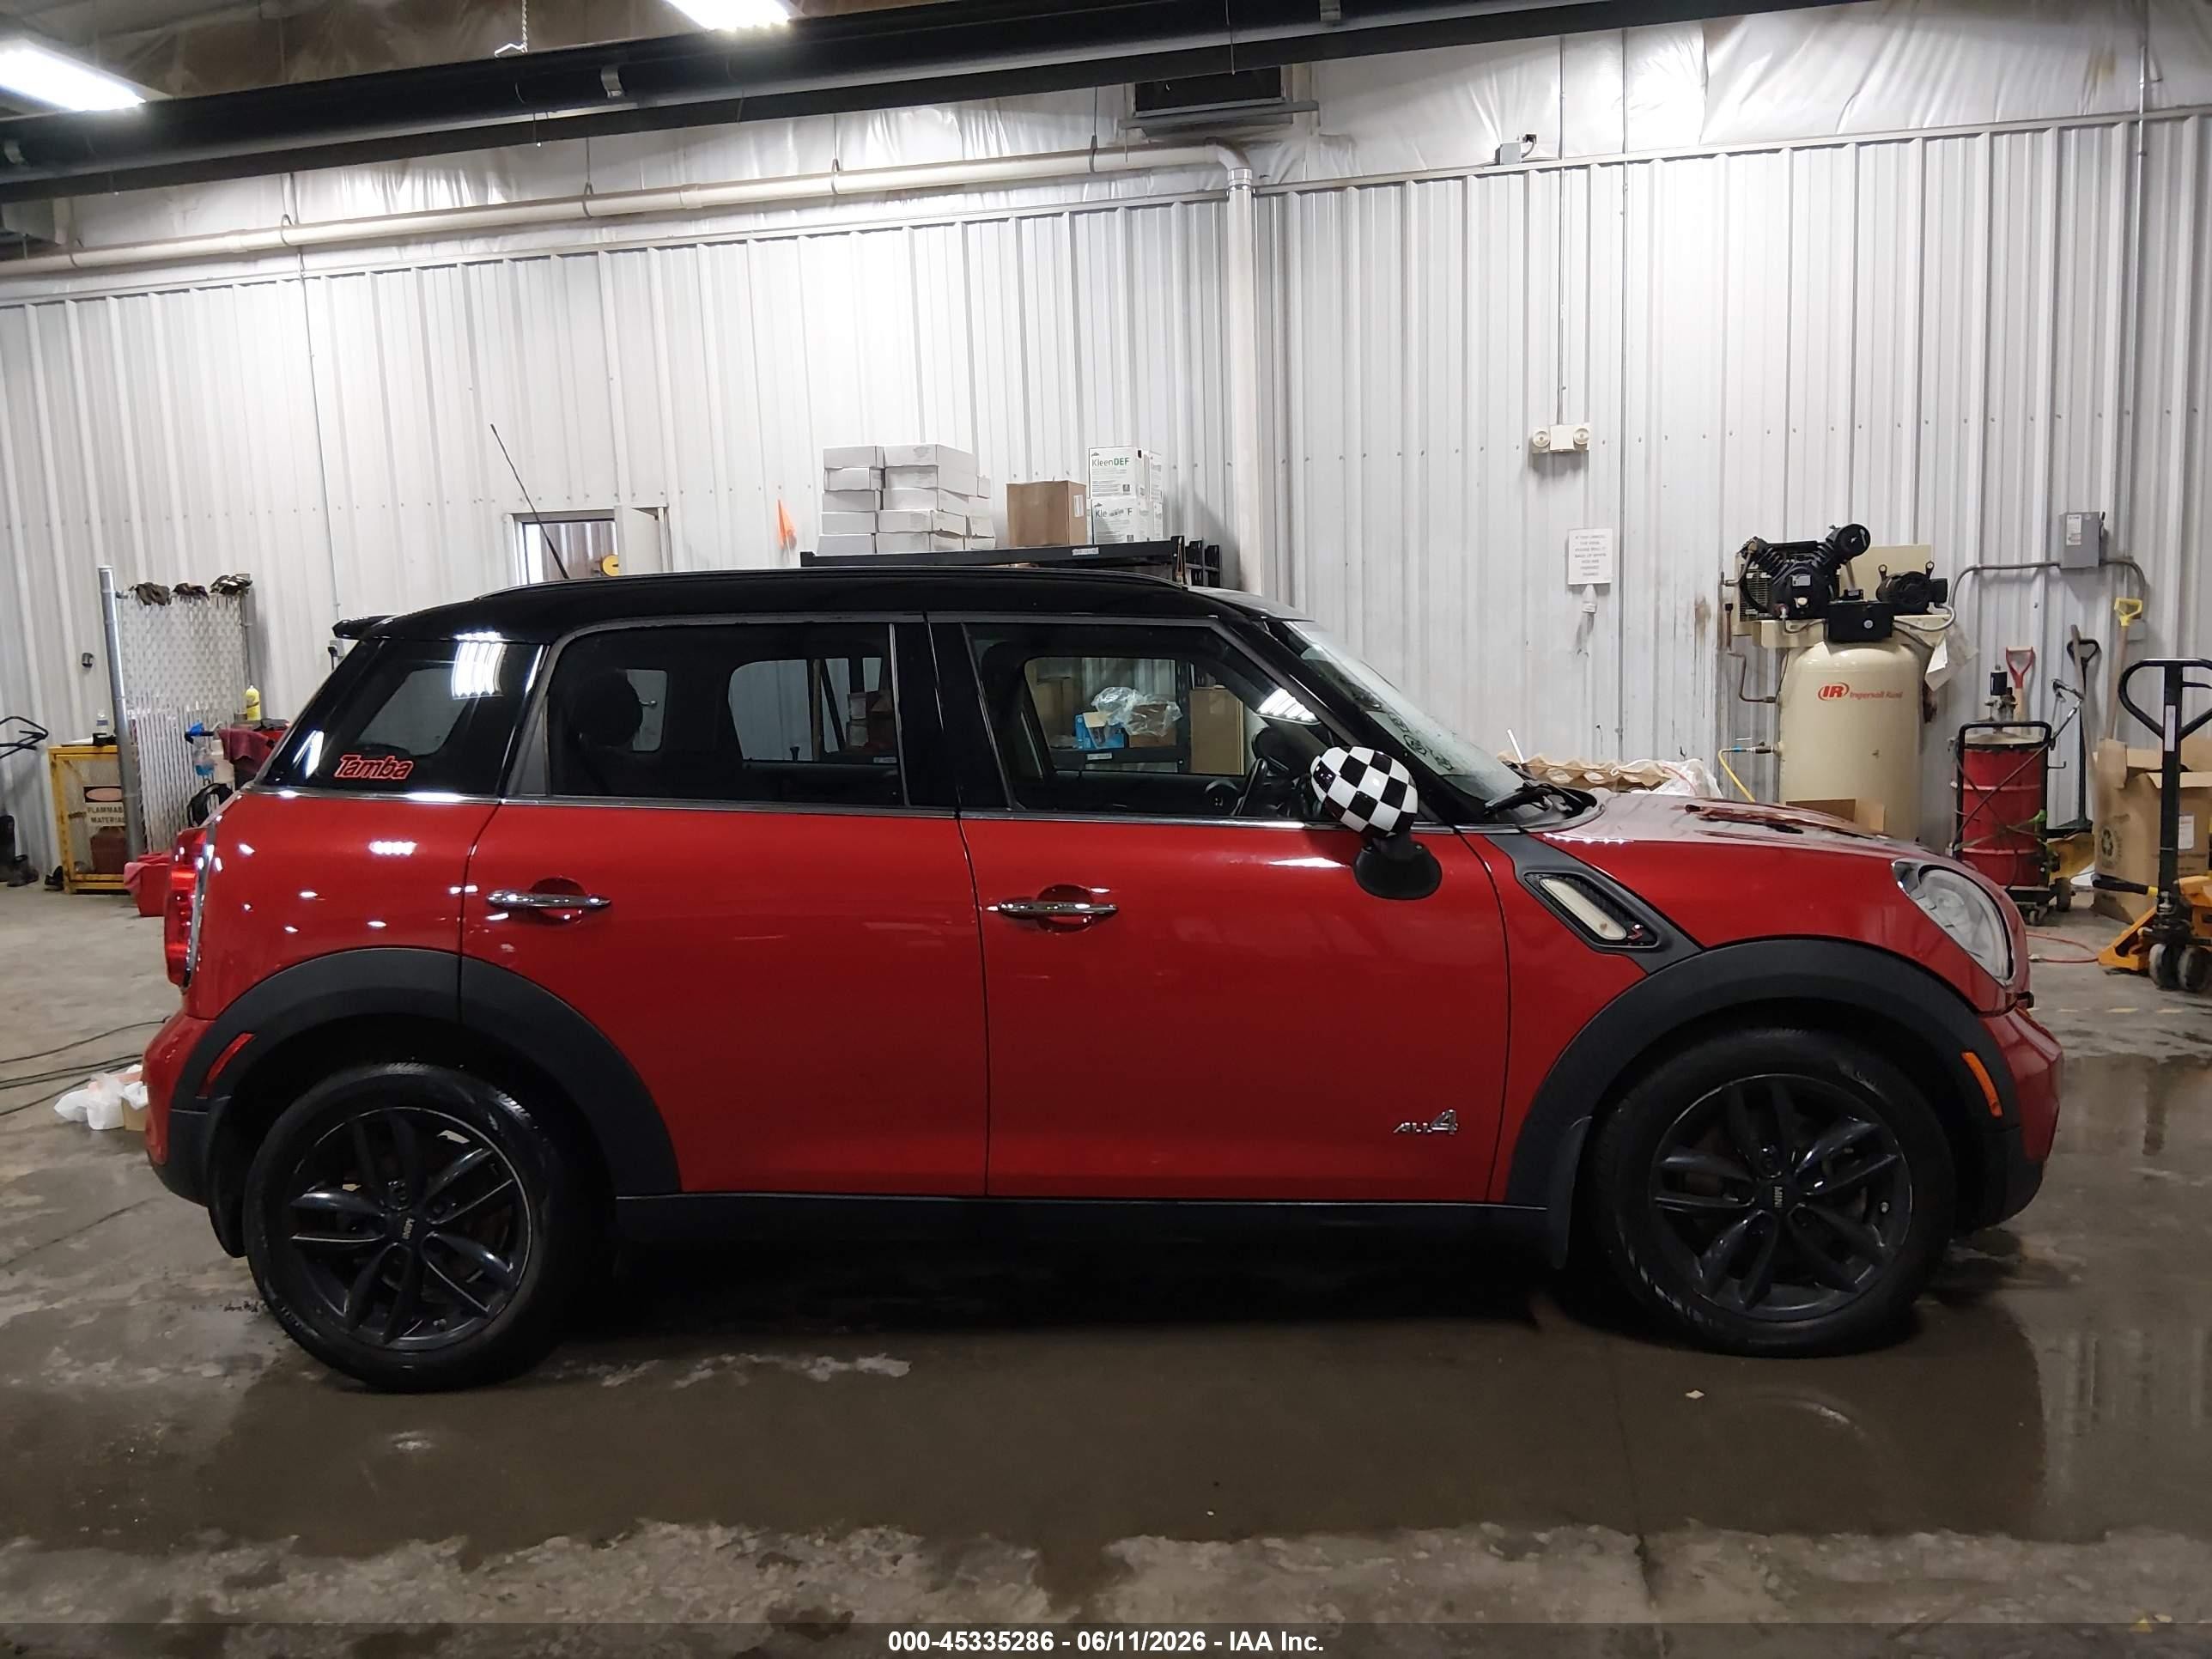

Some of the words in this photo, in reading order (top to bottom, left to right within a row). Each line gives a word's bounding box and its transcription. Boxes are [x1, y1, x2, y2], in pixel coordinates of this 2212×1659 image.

[1091, 457, 1130, 467] KleenDEF
[1821, 684, 1845, 698] IR
[334, 755, 413, 780] Tamba
